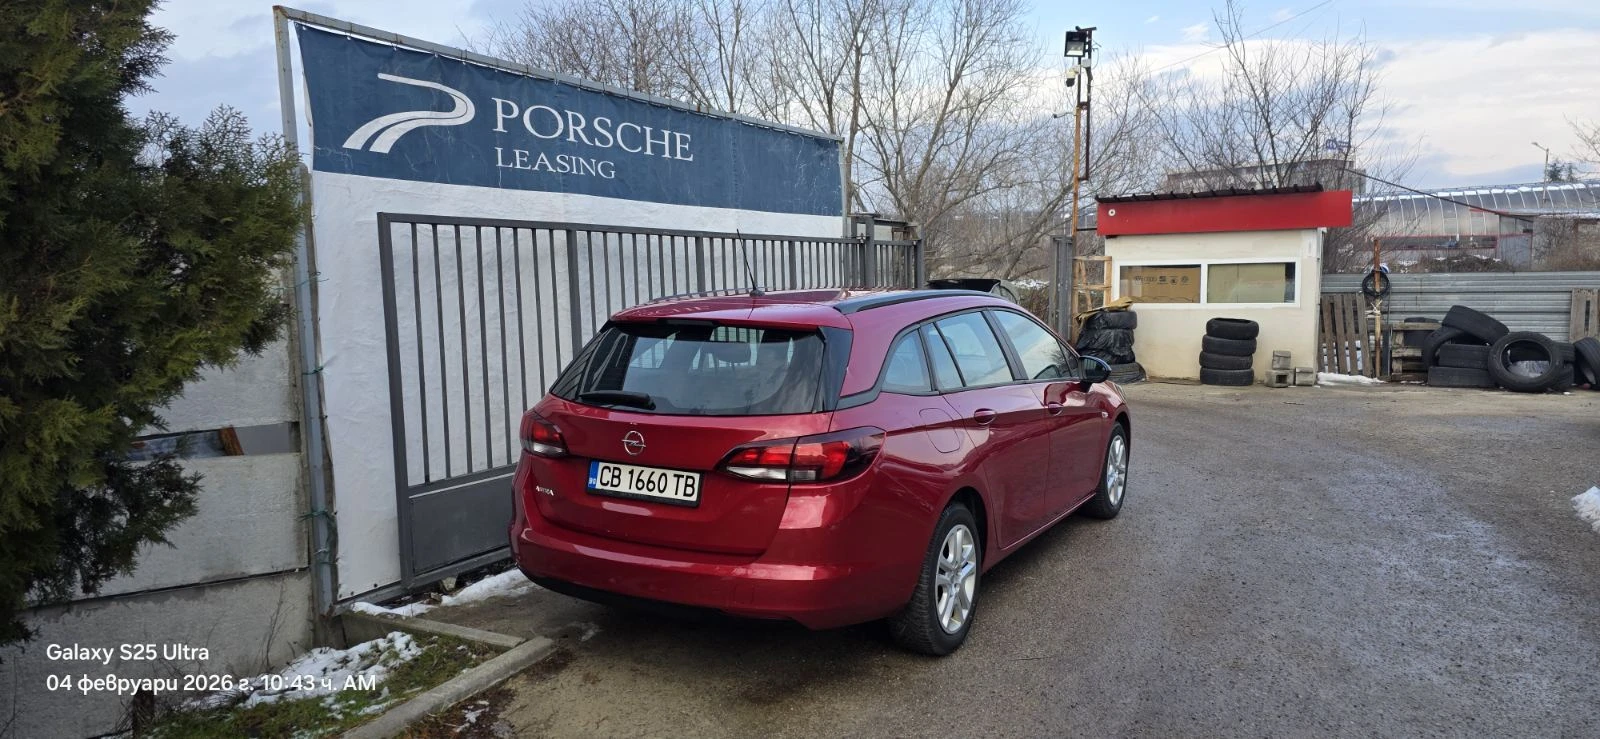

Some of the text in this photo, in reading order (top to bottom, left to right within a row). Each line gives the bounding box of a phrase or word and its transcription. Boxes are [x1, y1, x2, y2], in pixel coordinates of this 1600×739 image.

[491, 97, 694, 162] PORSCHE
[494, 147, 616, 179] LEASING
[599, 465, 696, 498] CB 1660 TB
